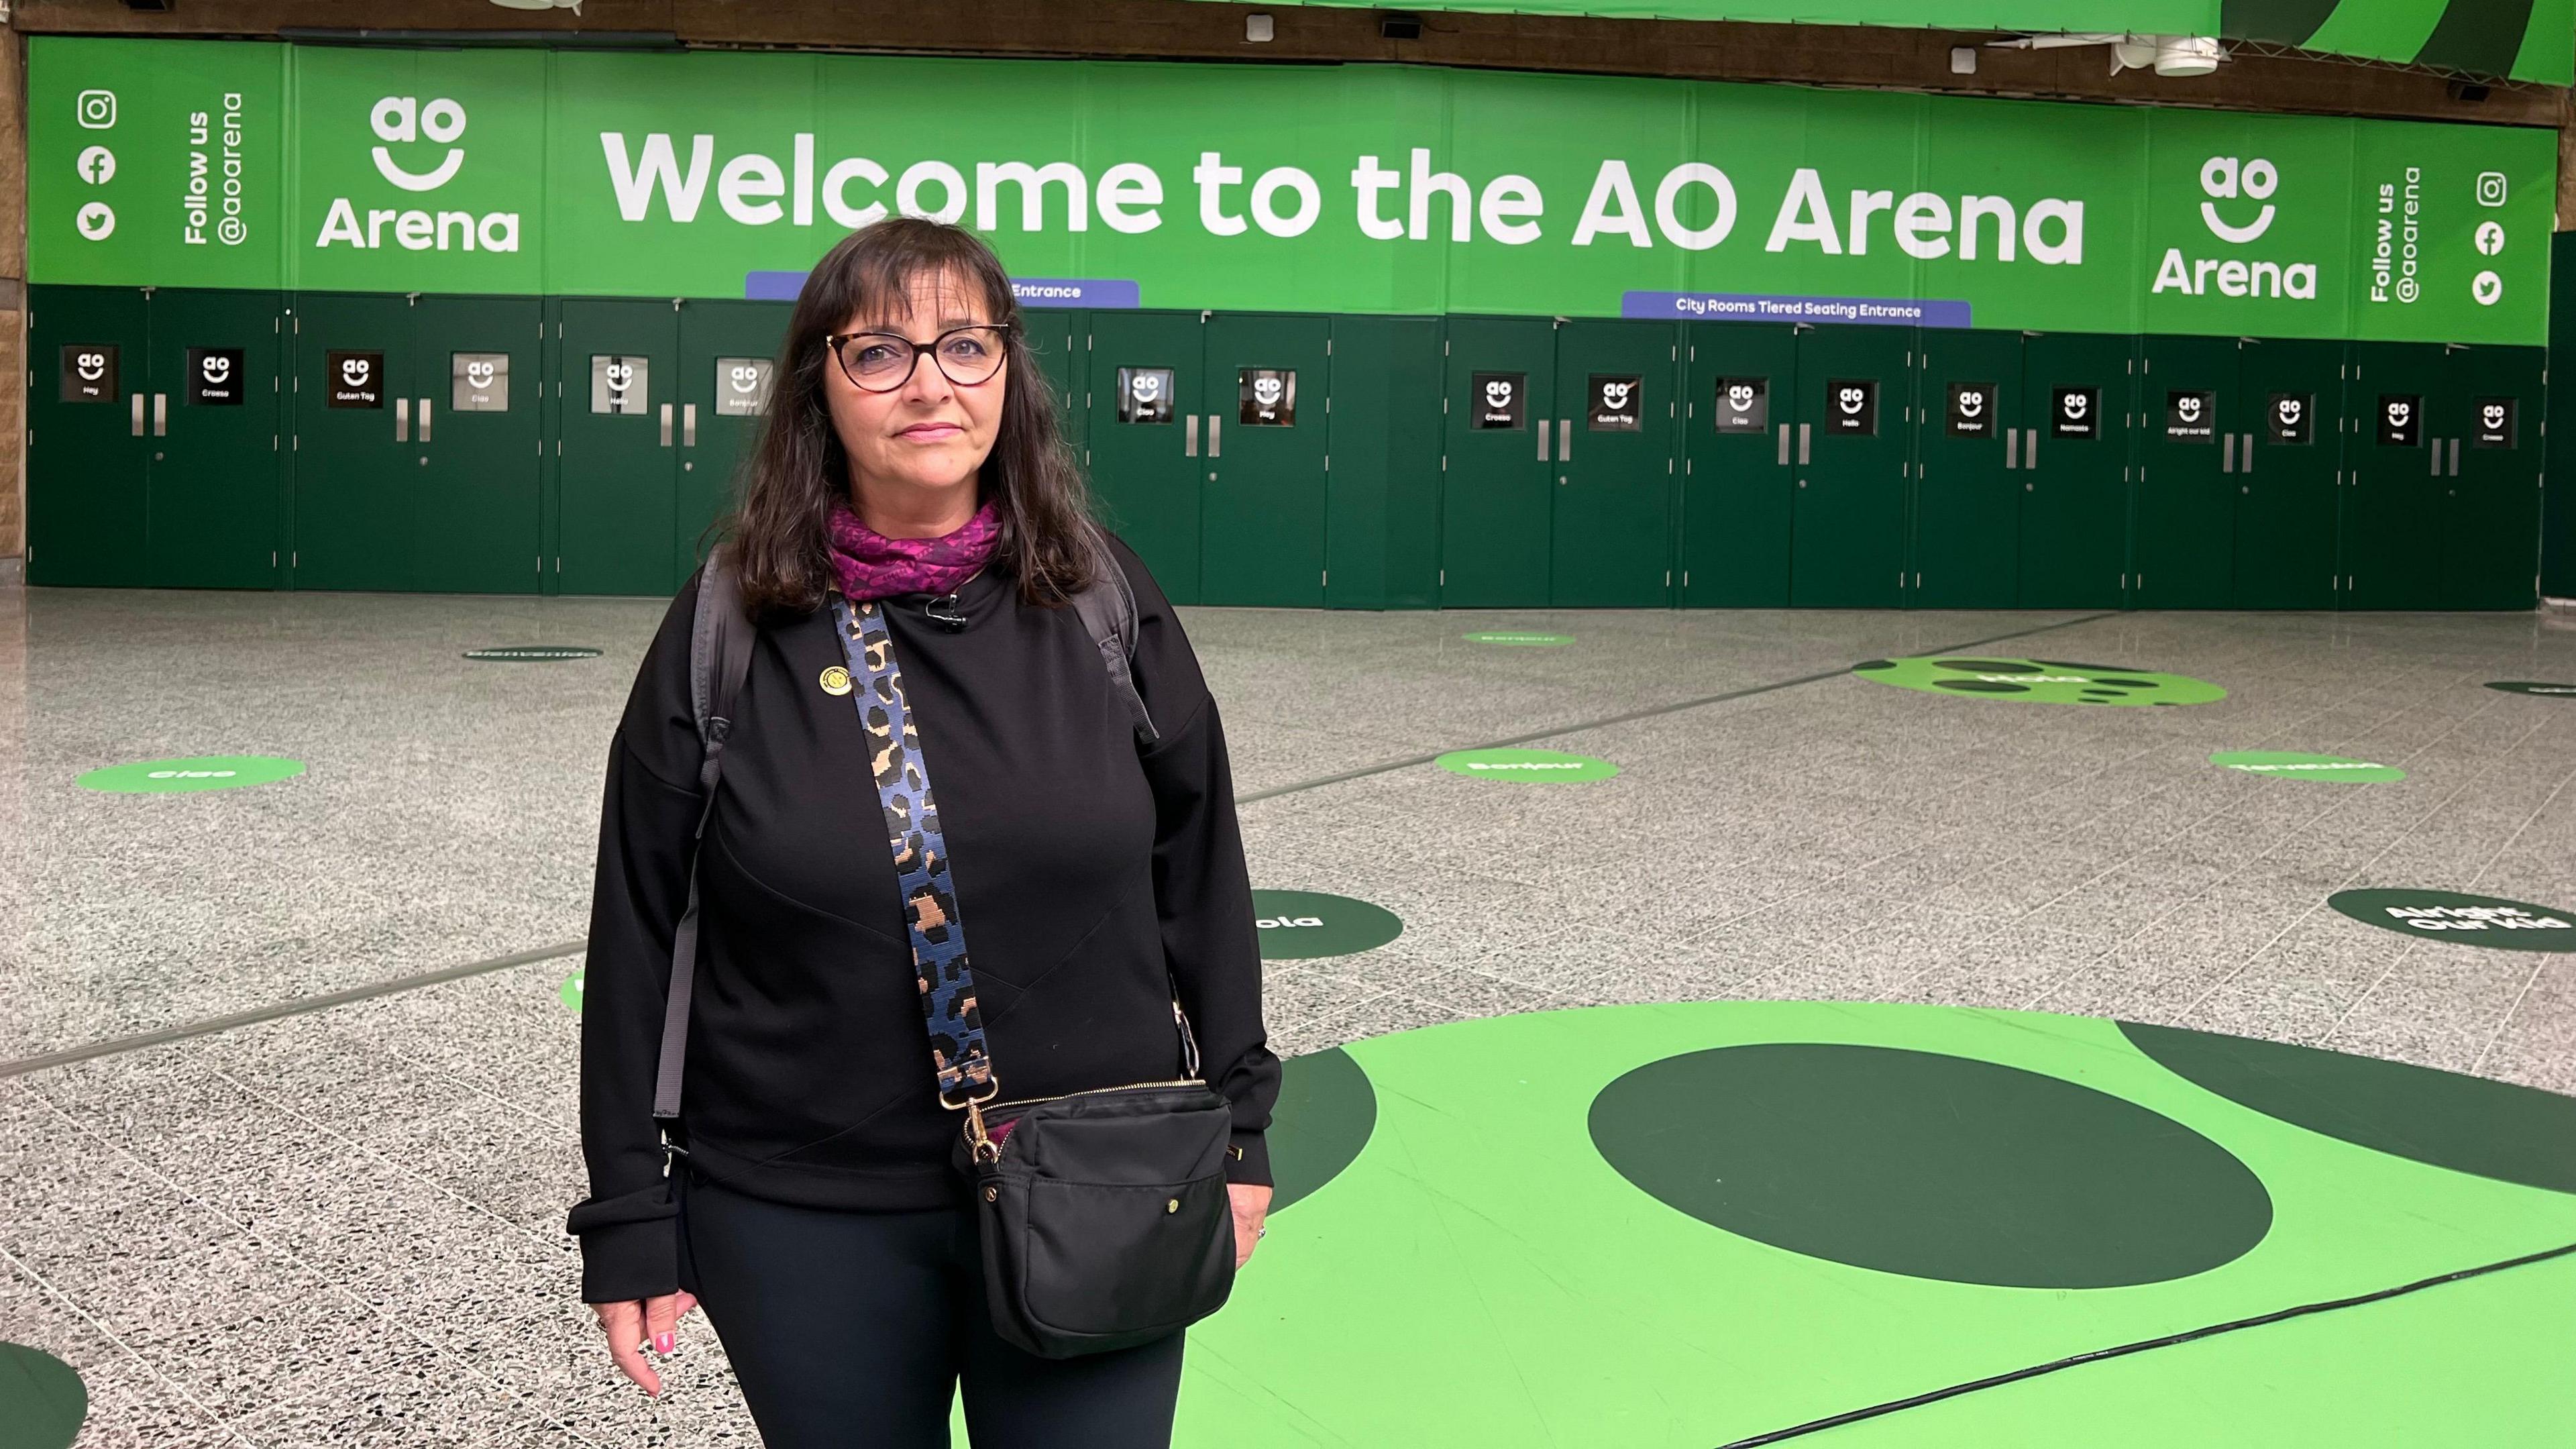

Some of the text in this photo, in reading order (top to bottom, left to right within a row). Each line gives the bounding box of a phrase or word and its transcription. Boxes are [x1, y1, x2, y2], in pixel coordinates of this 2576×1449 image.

[370, 97, 466, 143] ao
[217, 93, 247, 246] @aoarena
[184, 111, 208, 244] Follow us
[2200, 156, 2278, 200] ao
[600, 132, 2084, 265] Welcome to the AO Arena
[316, 198, 519, 252] Arena
[2396, 167, 2420, 303] @aoarena
[2371, 184, 2394, 303] Follow us
[2152, 248, 2316, 299] Arena
[1012, 284, 1081, 298] Entrance
[1676, 298, 1921, 319] City Rooms Tiered Seating Entrance
[78, 354, 104, 367] ao
[203, 357, 229, 370] ao
[343, 360, 369, 373] ao
[468, 362, 493, 376] ao
[607, 365, 633, 378] ao
[732, 367, 757, 380] ao
[1132, 376, 1159, 390] ao
[1254, 378, 1281, 392] ao
[1486, 382, 1512, 395] ao
[1603, 383, 1628, 396] ao
[337, 392, 375, 402] Guten Tag
[1729, 386, 1754, 399] ao
[1840, 388, 1863, 402] ao
[1960, 392, 1982, 405] ao
[2064, 394, 2086, 407] ao
[2179, 397, 2200, 411] ao
[2279, 400, 2300, 413] ao
[2388, 403, 2409, 415] ao
[2483, 405, 2504, 417] ao
[1597, 415, 1633, 424] Guten Tag
[1255, 916, 1324, 928] ola
[2407, 918, 2489, 930] Our
